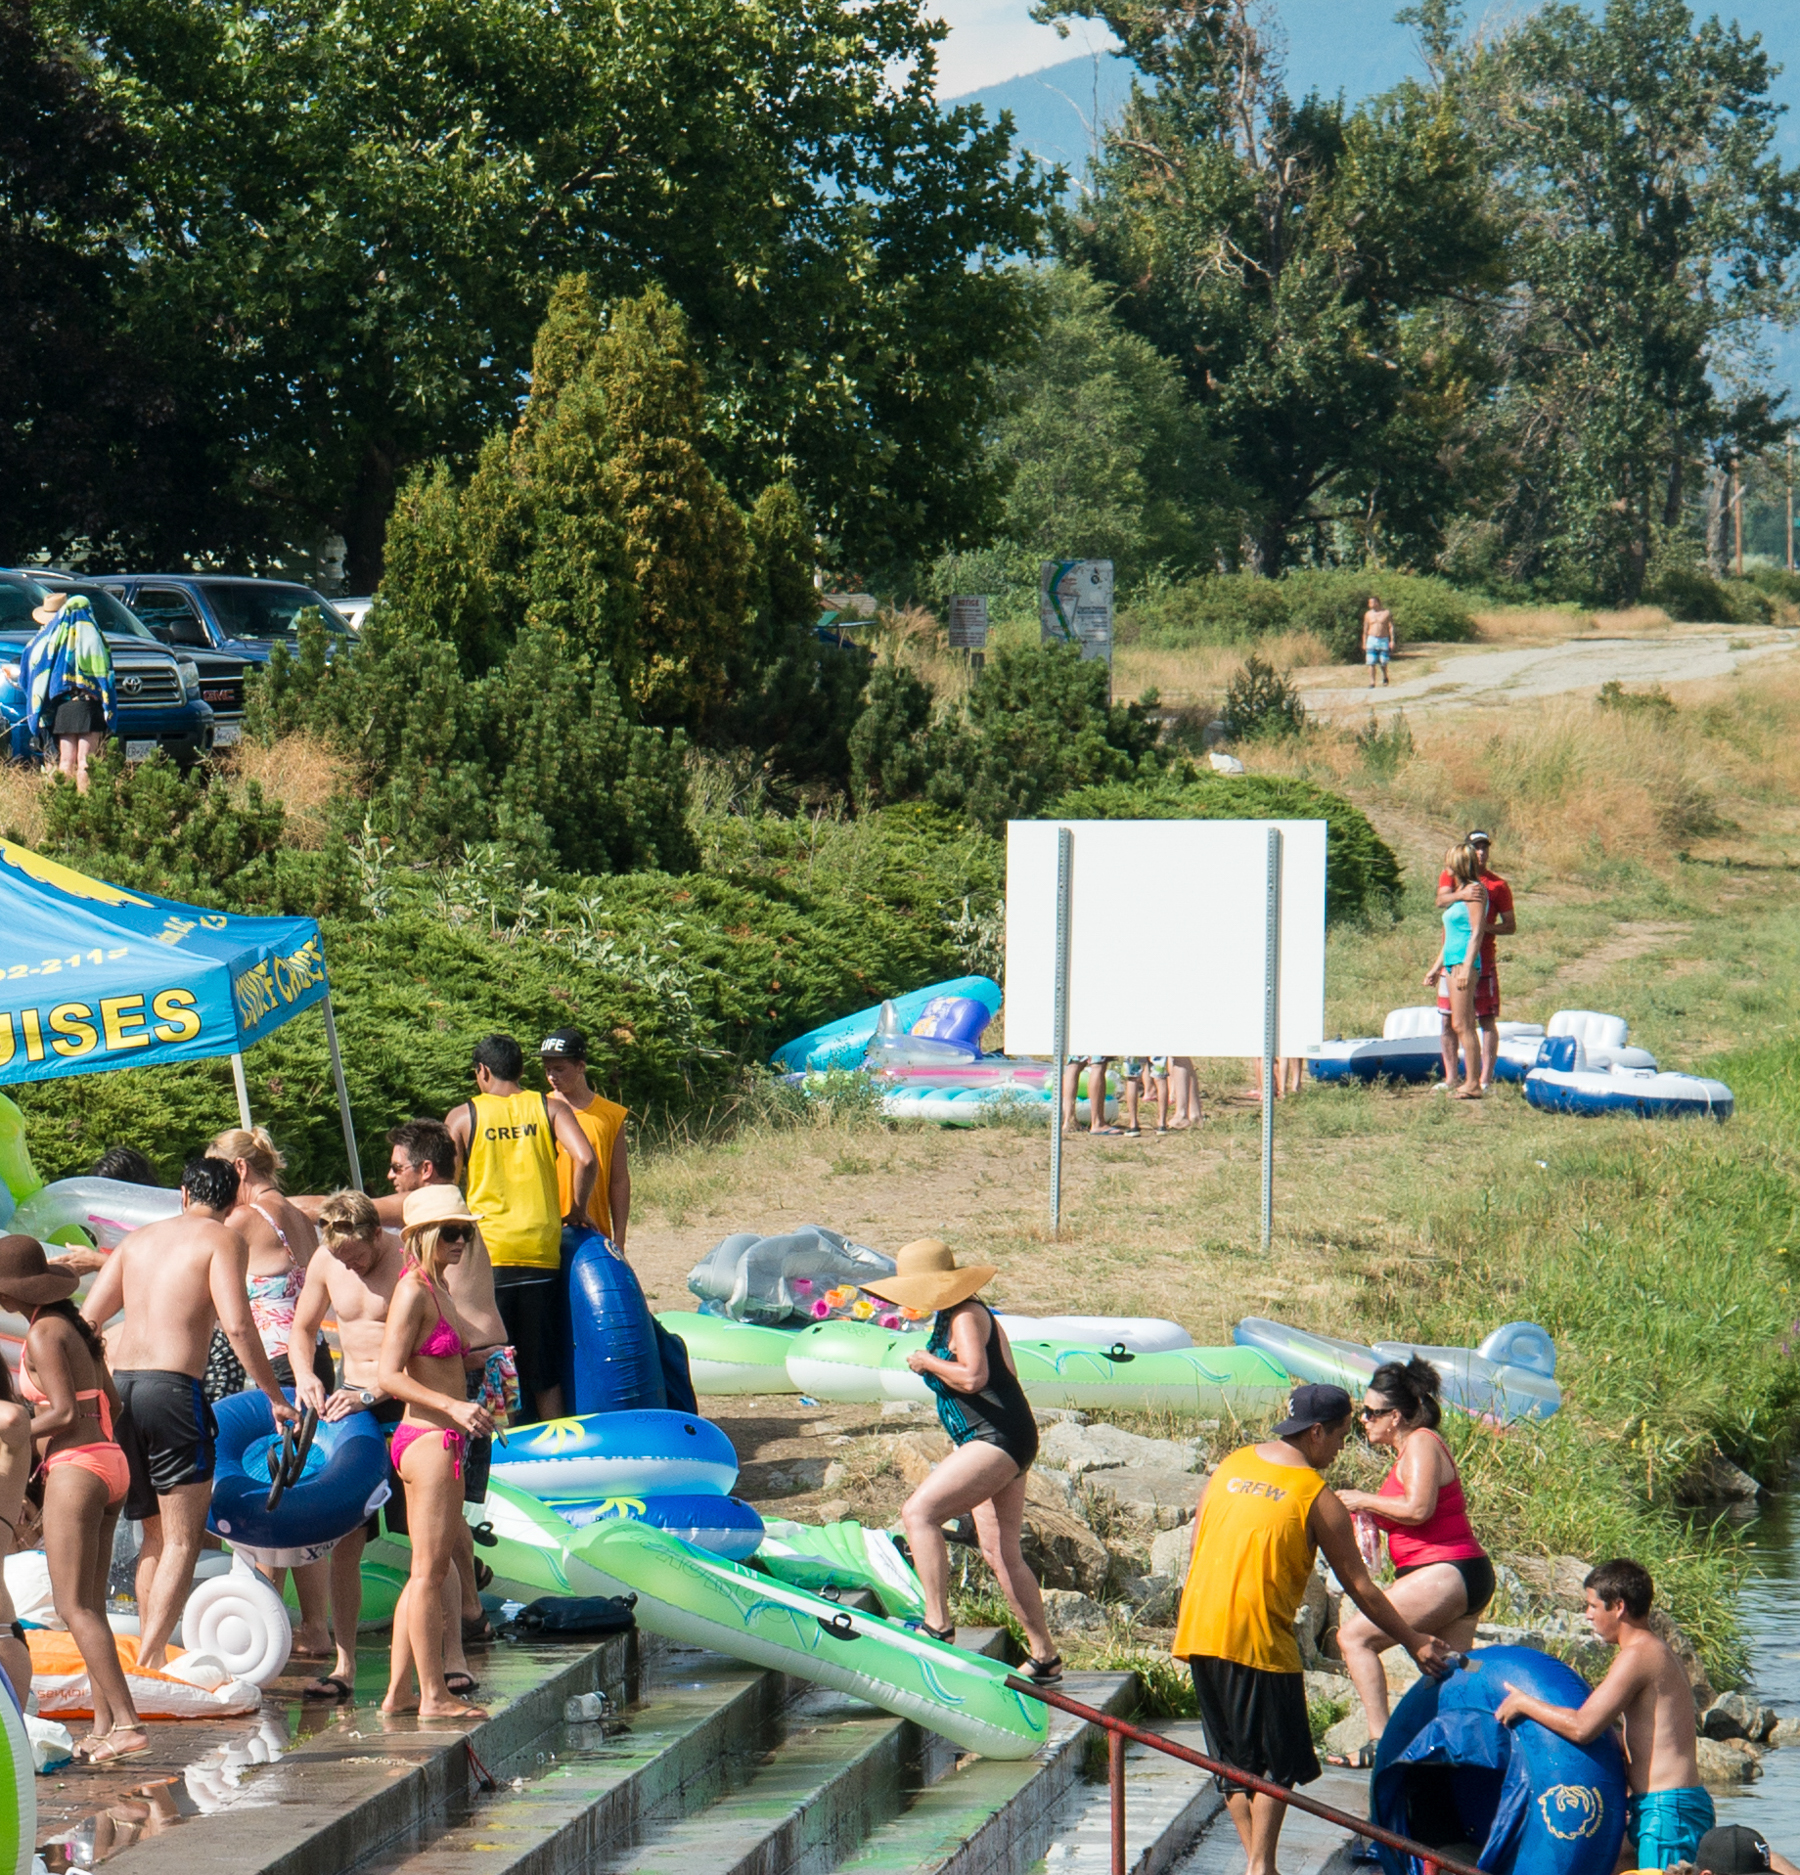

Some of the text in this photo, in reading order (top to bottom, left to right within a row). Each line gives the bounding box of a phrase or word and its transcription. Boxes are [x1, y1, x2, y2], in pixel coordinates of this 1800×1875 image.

[203, 689, 235, 701] GMC
[485, 1123, 538, 1141] CREW
[1226, 1477, 1288, 1502] CREW
